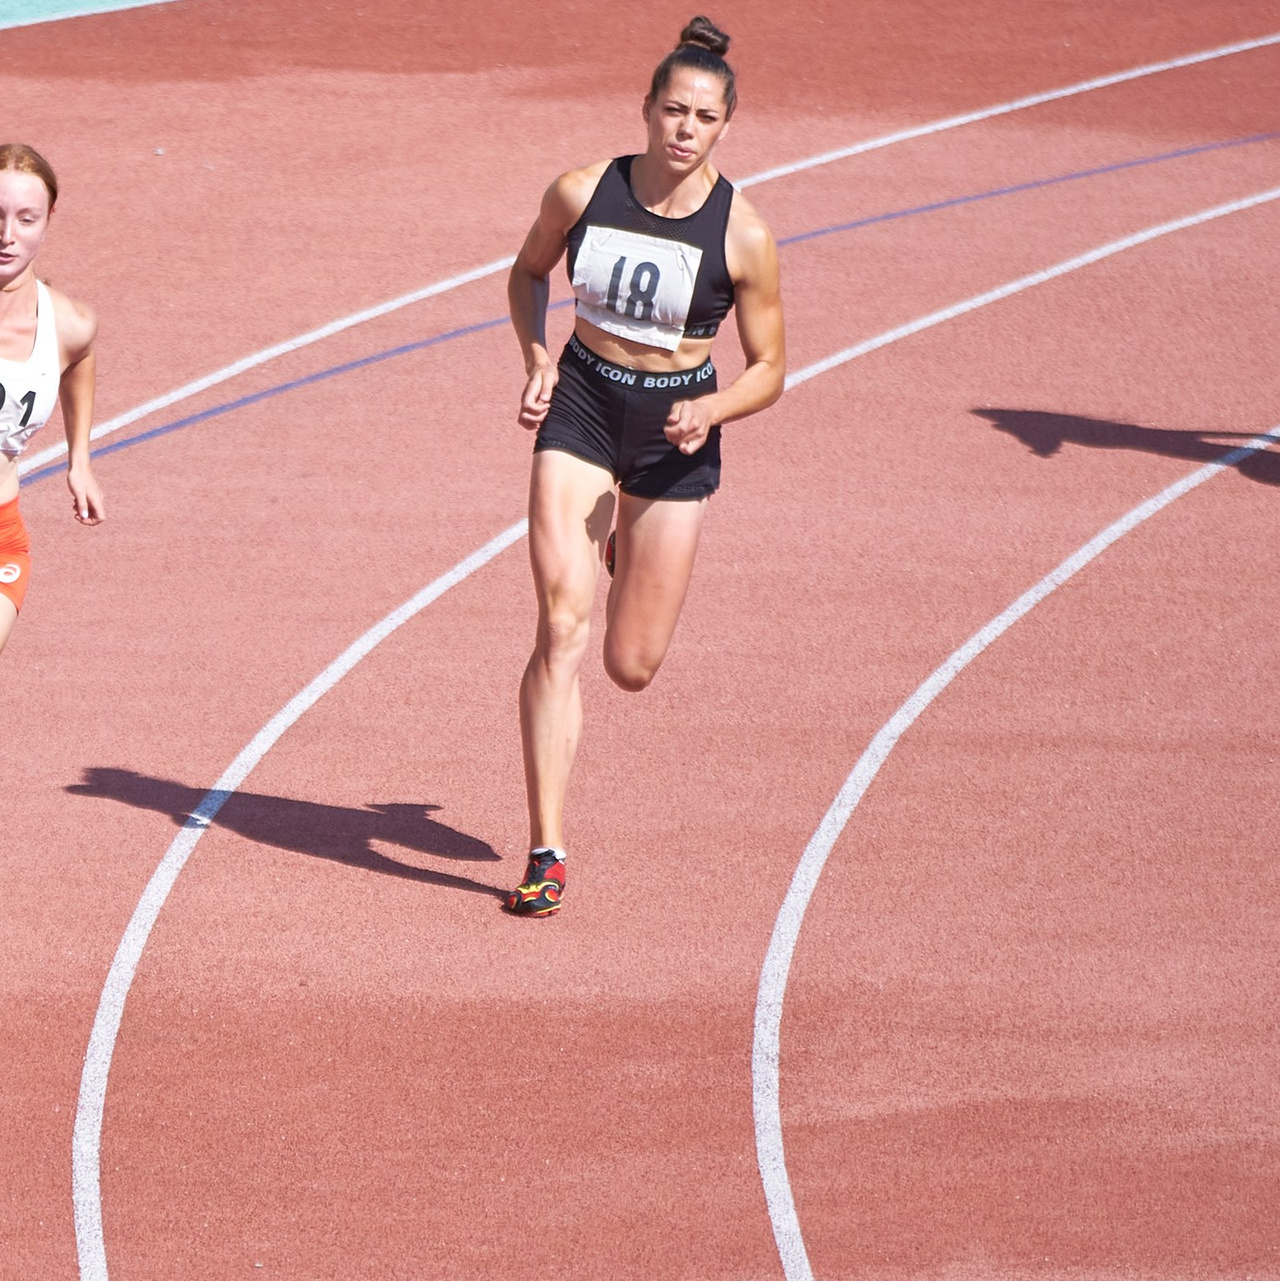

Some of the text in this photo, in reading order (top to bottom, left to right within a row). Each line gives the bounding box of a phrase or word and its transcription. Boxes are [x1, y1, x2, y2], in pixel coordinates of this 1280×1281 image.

[606, 256, 660, 320] 18
[595, 363, 637, 386] ICON
[643, 373, 693, 388] BODY
